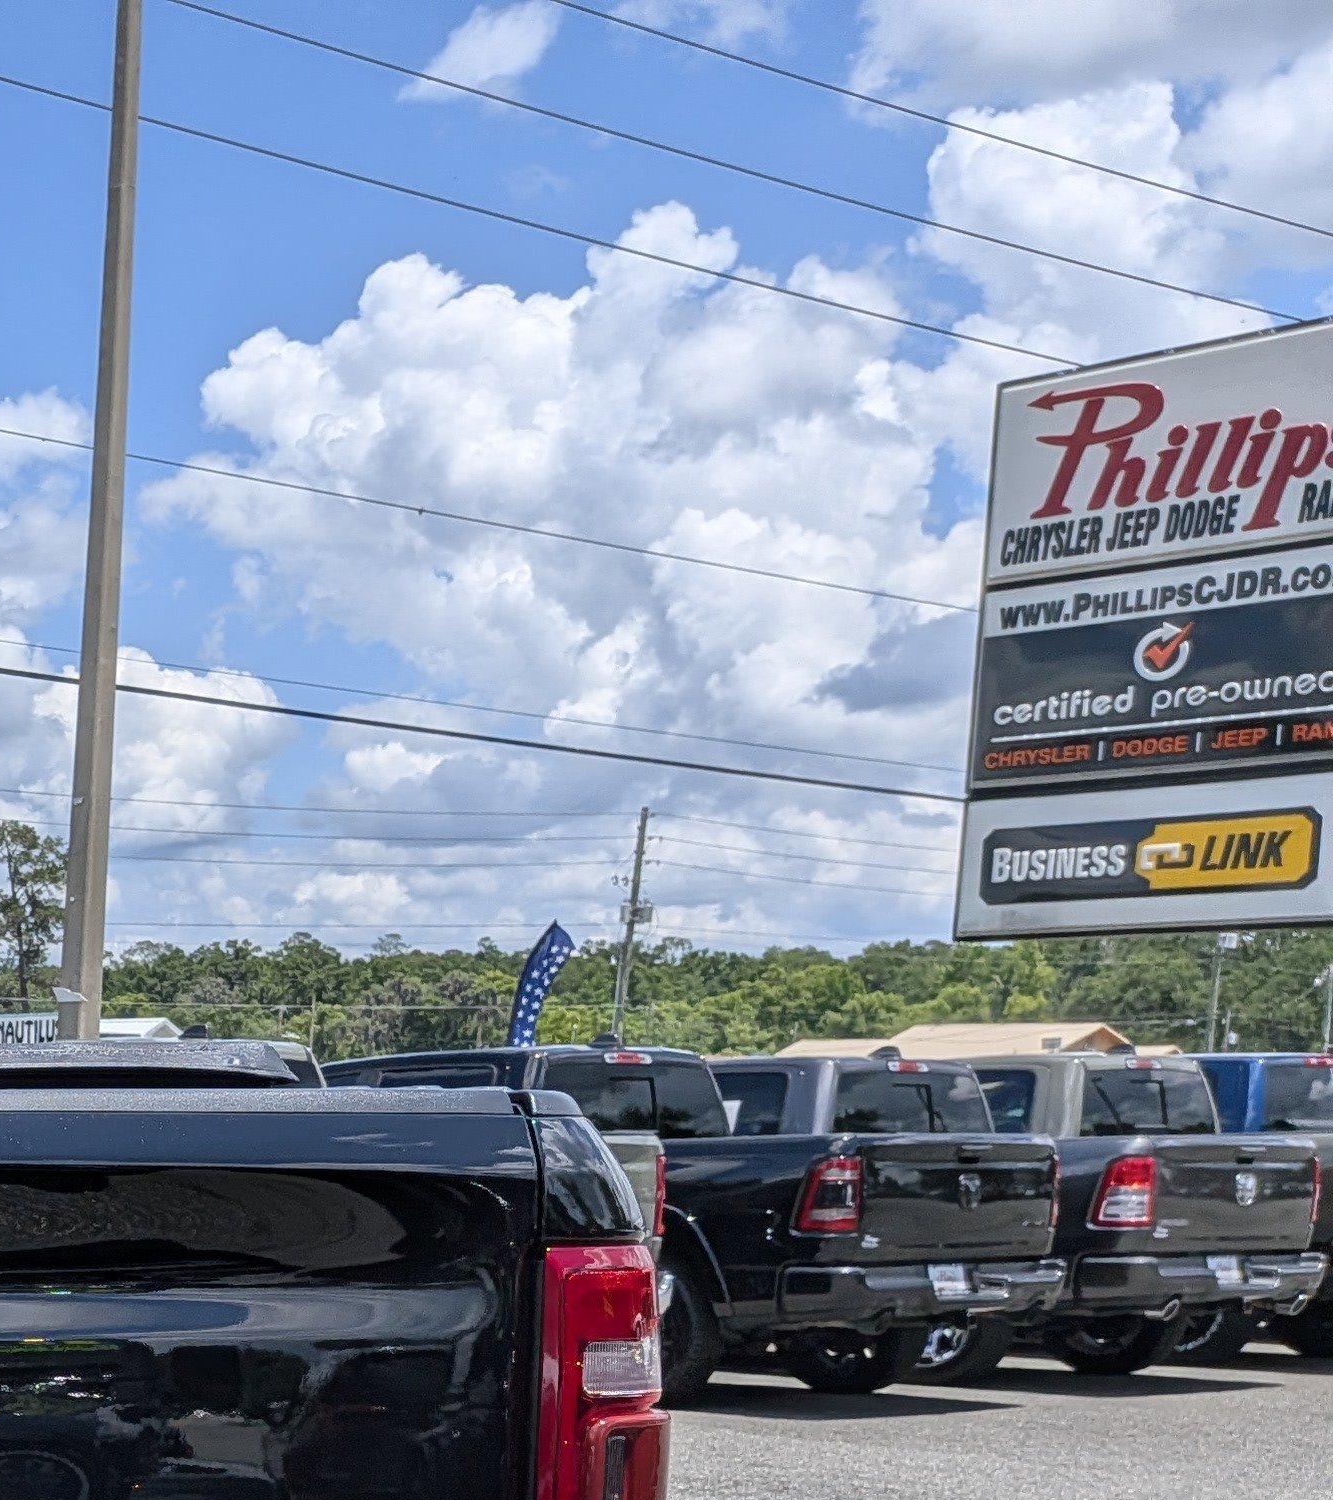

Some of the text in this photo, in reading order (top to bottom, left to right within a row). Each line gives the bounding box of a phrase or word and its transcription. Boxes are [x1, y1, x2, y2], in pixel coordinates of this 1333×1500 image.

[1000, 479, 1333, 567] CHRYSLER JEEP DODGE RA
[1000, 563, 1333, 630] WWW.PHILLIPSCJDR.CO
[993, 686, 1134, 726] certified
[984, 743, 1090, 770] CHRYSLER
[1112, 735, 1189, 758] DODGE
[1210, 727, 1269, 749] JEEP
[991, 830, 1293, 884] BUSINESS LINK
